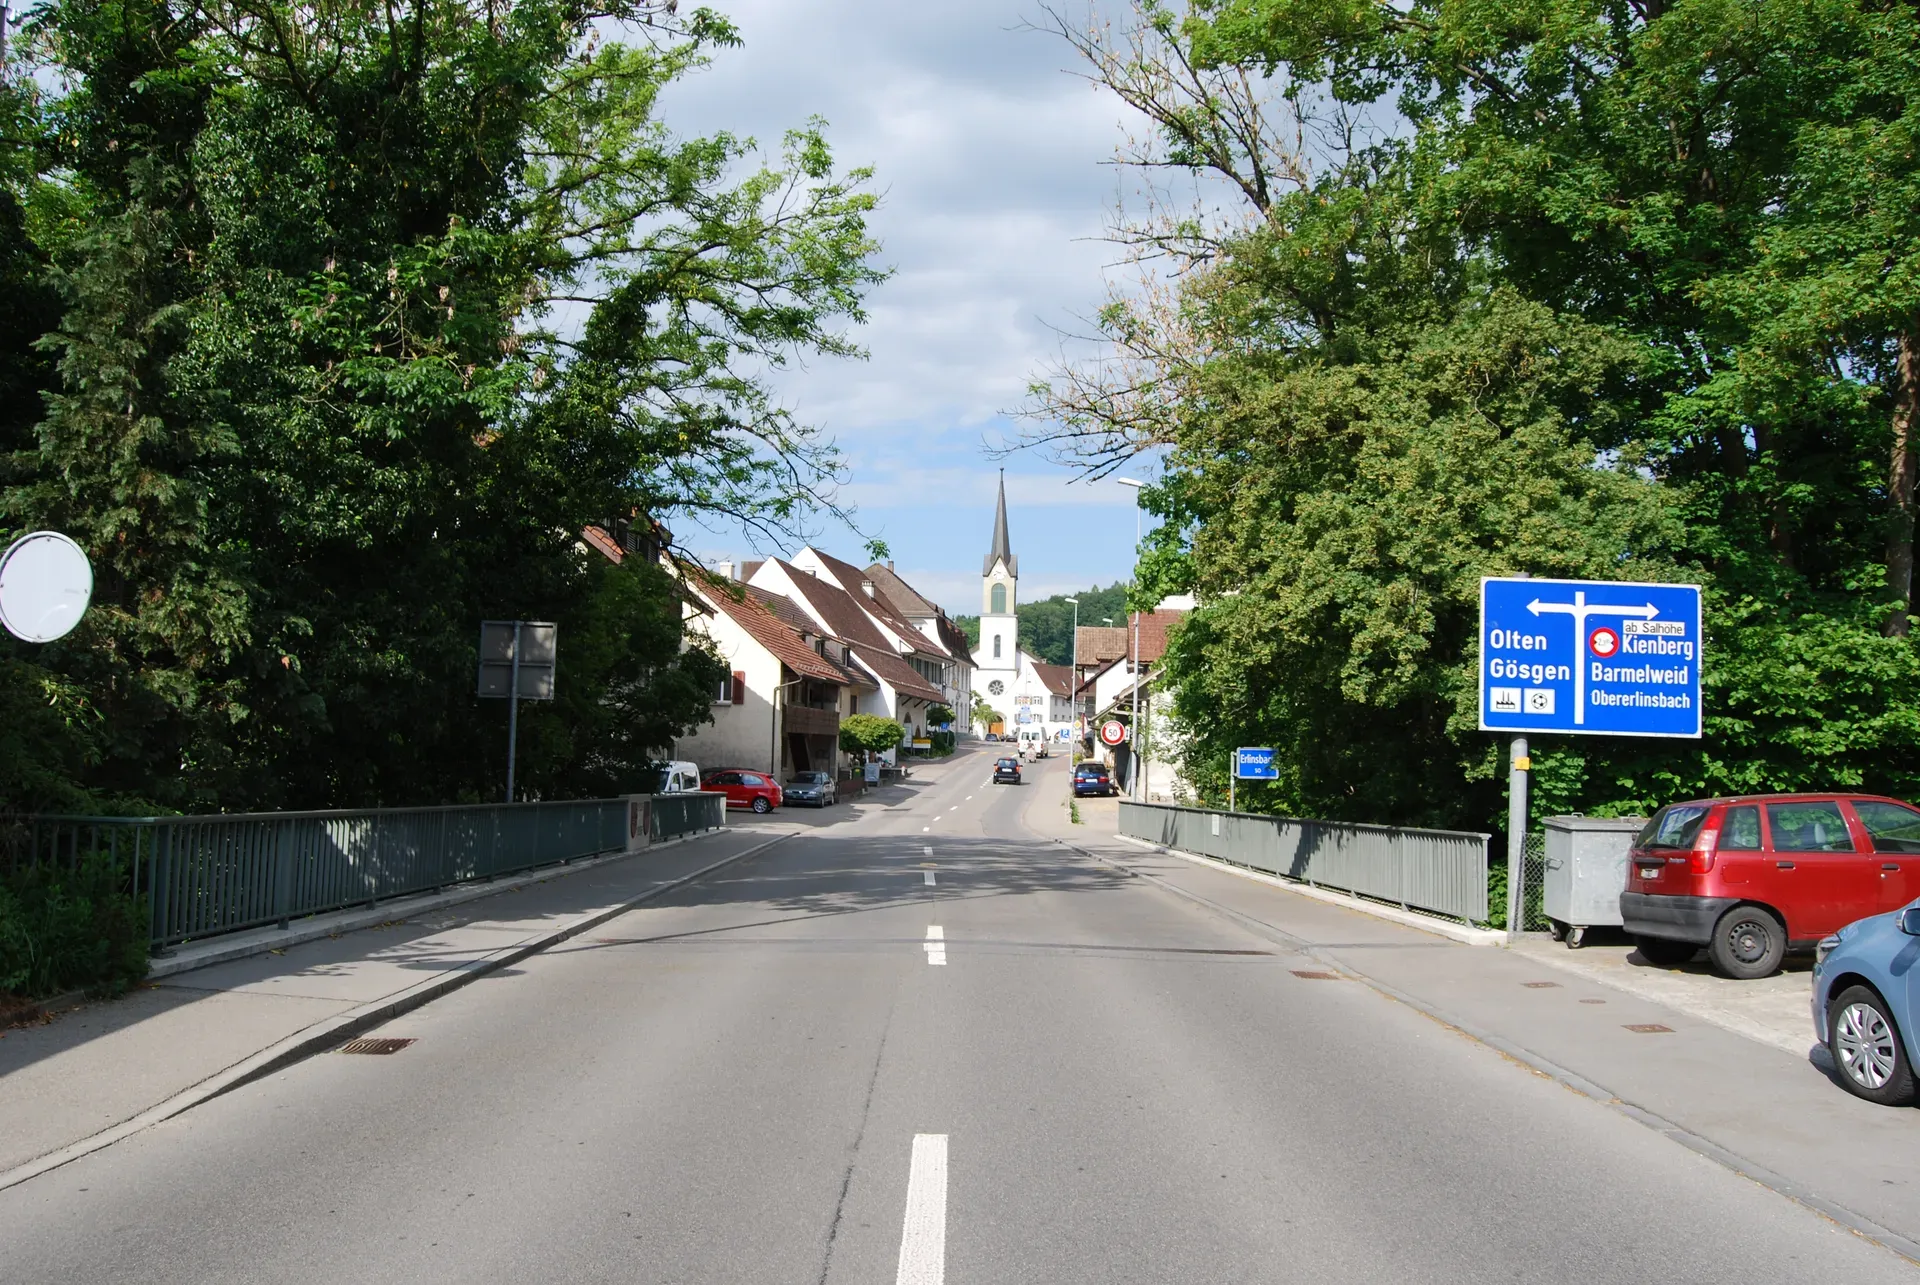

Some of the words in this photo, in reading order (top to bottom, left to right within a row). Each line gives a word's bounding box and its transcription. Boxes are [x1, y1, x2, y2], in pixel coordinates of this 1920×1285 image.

[1625, 622, 1638, 633] ab
[1642, 622, 1684, 635] Salhöhe
[1490, 629, 1547, 650] Olten
[1622, 634, 1693, 660] Kienberg
[1490, 658, 1570, 684] Gösgen
[1591, 662, 1688, 685] Barmelweid
[1591, 689, 1690, 709] Obererlinsbach
[1108, 729, 1118, 737] 50
